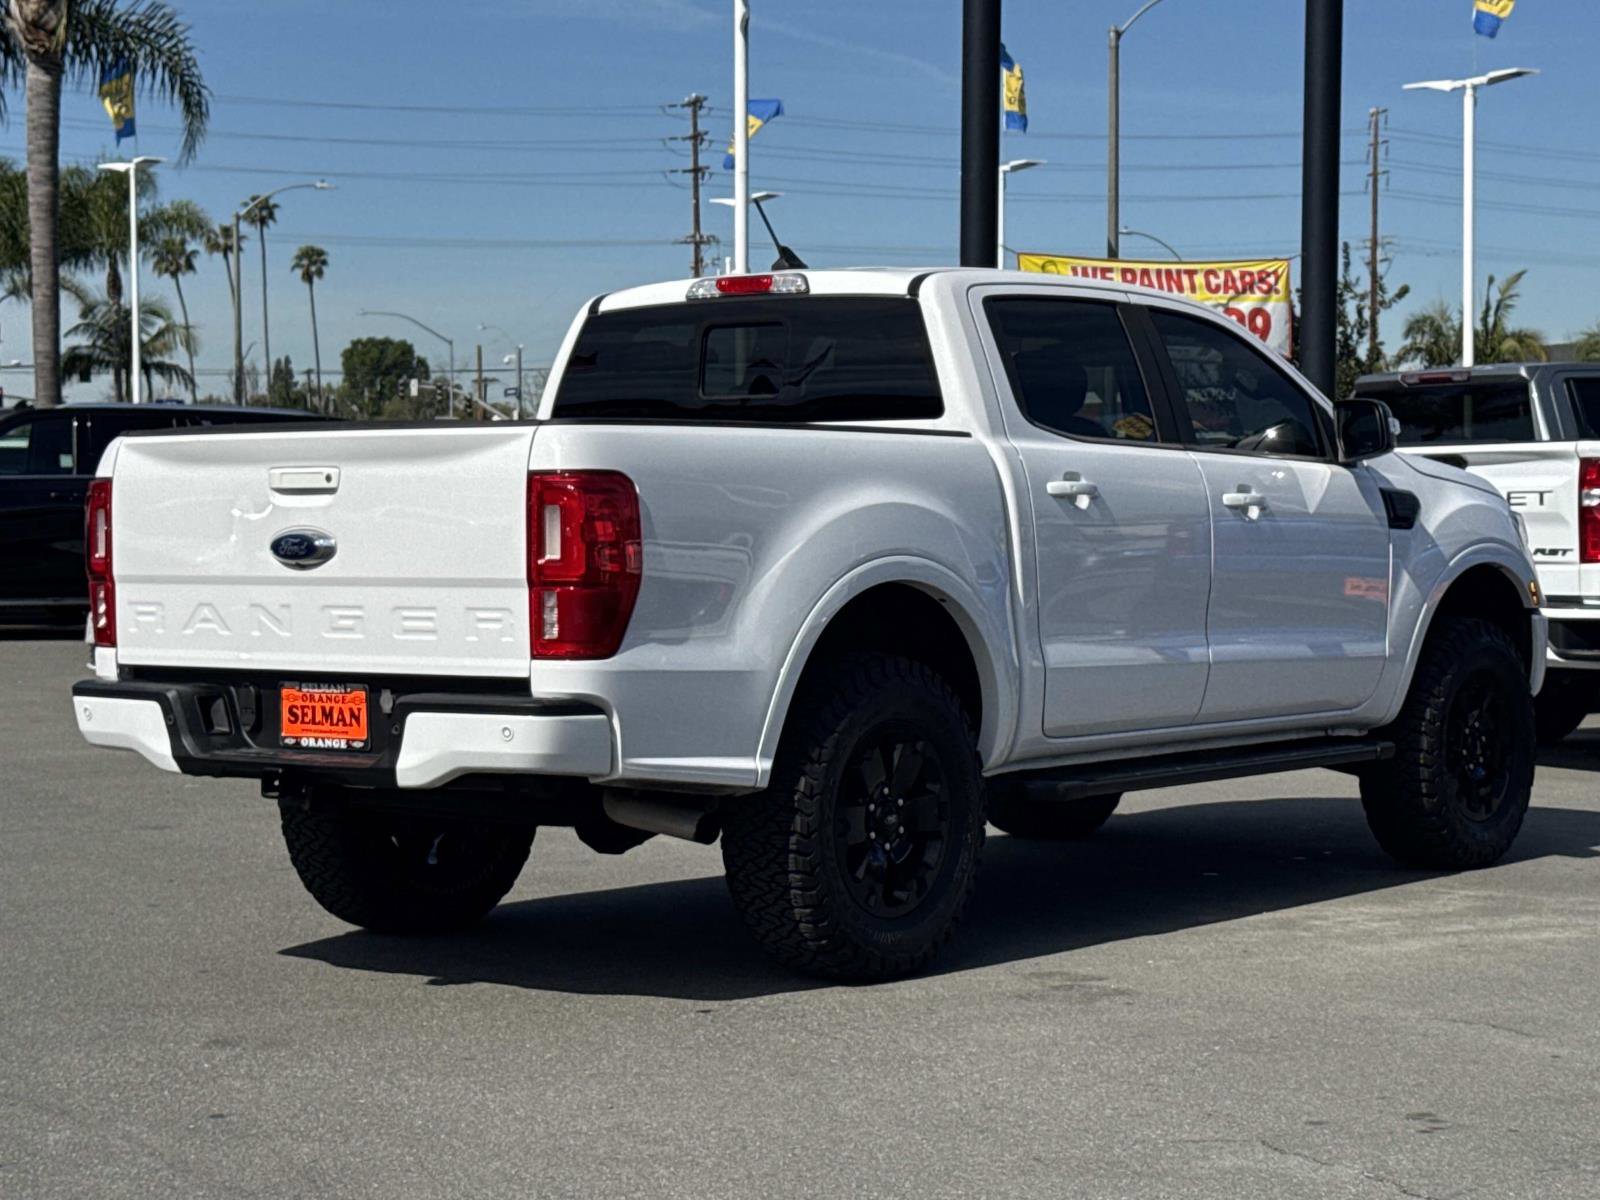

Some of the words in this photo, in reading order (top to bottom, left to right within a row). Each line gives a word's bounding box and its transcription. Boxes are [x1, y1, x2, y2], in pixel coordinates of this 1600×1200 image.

[1120, 267, 1198, 294] PAINT
[1203, 268, 1281, 295] CARS!
[278, 538, 309, 555] Ford
[127, 601, 515, 642] RANGER
[301, 694, 348, 704] ORANGE
[287, 704, 362, 728] SELMAN
[300, 737, 347, 749] ORANGE
